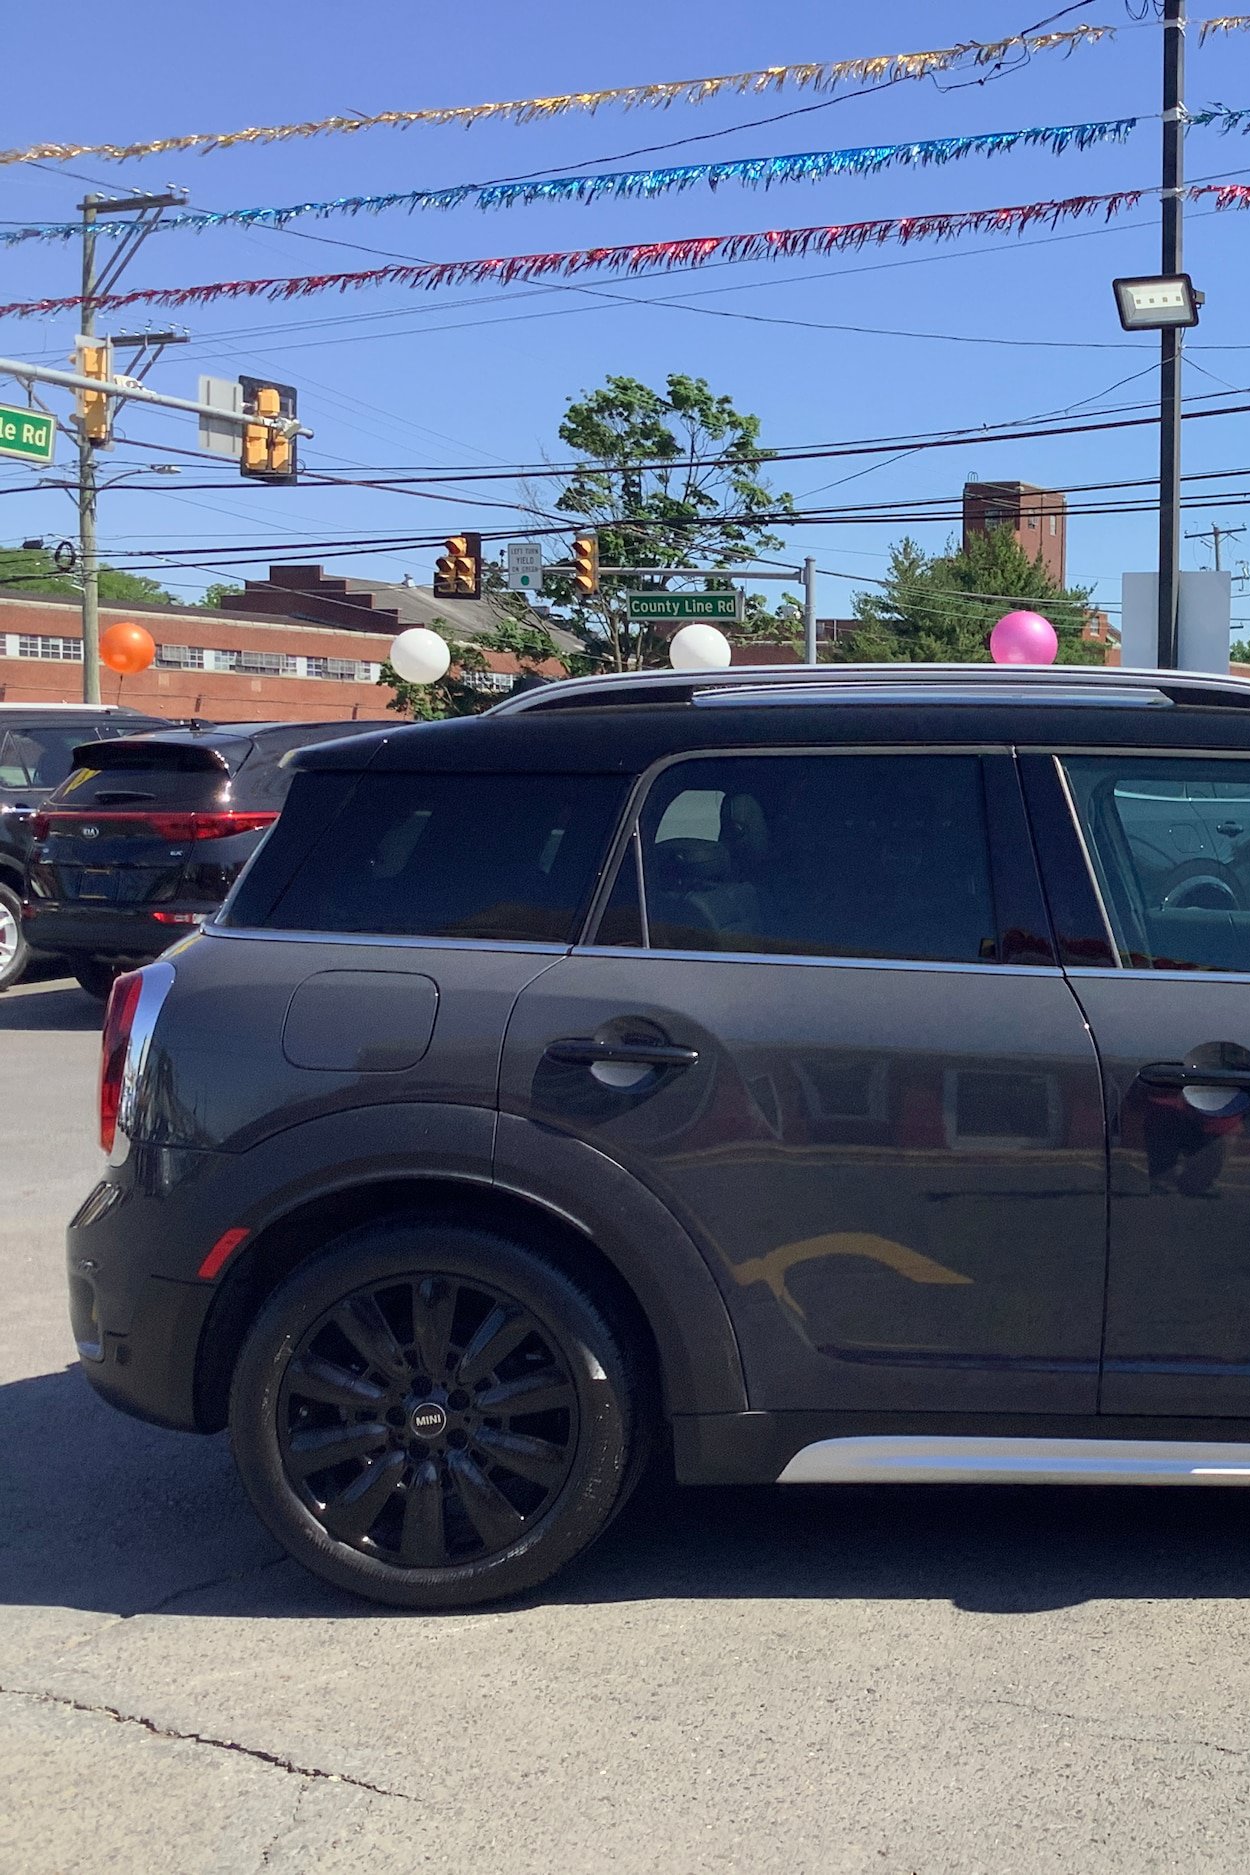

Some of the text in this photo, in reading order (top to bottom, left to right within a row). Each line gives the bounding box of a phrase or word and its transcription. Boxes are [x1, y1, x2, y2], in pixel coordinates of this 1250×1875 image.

[22, 424, 47, 447] Rd
[516, 556, 534, 565] YIELD
[631, 600, 735, 615] County Line Rd
[83, 828, 97, 837] KIA
[415, 1414, 442, 1427] MINI
